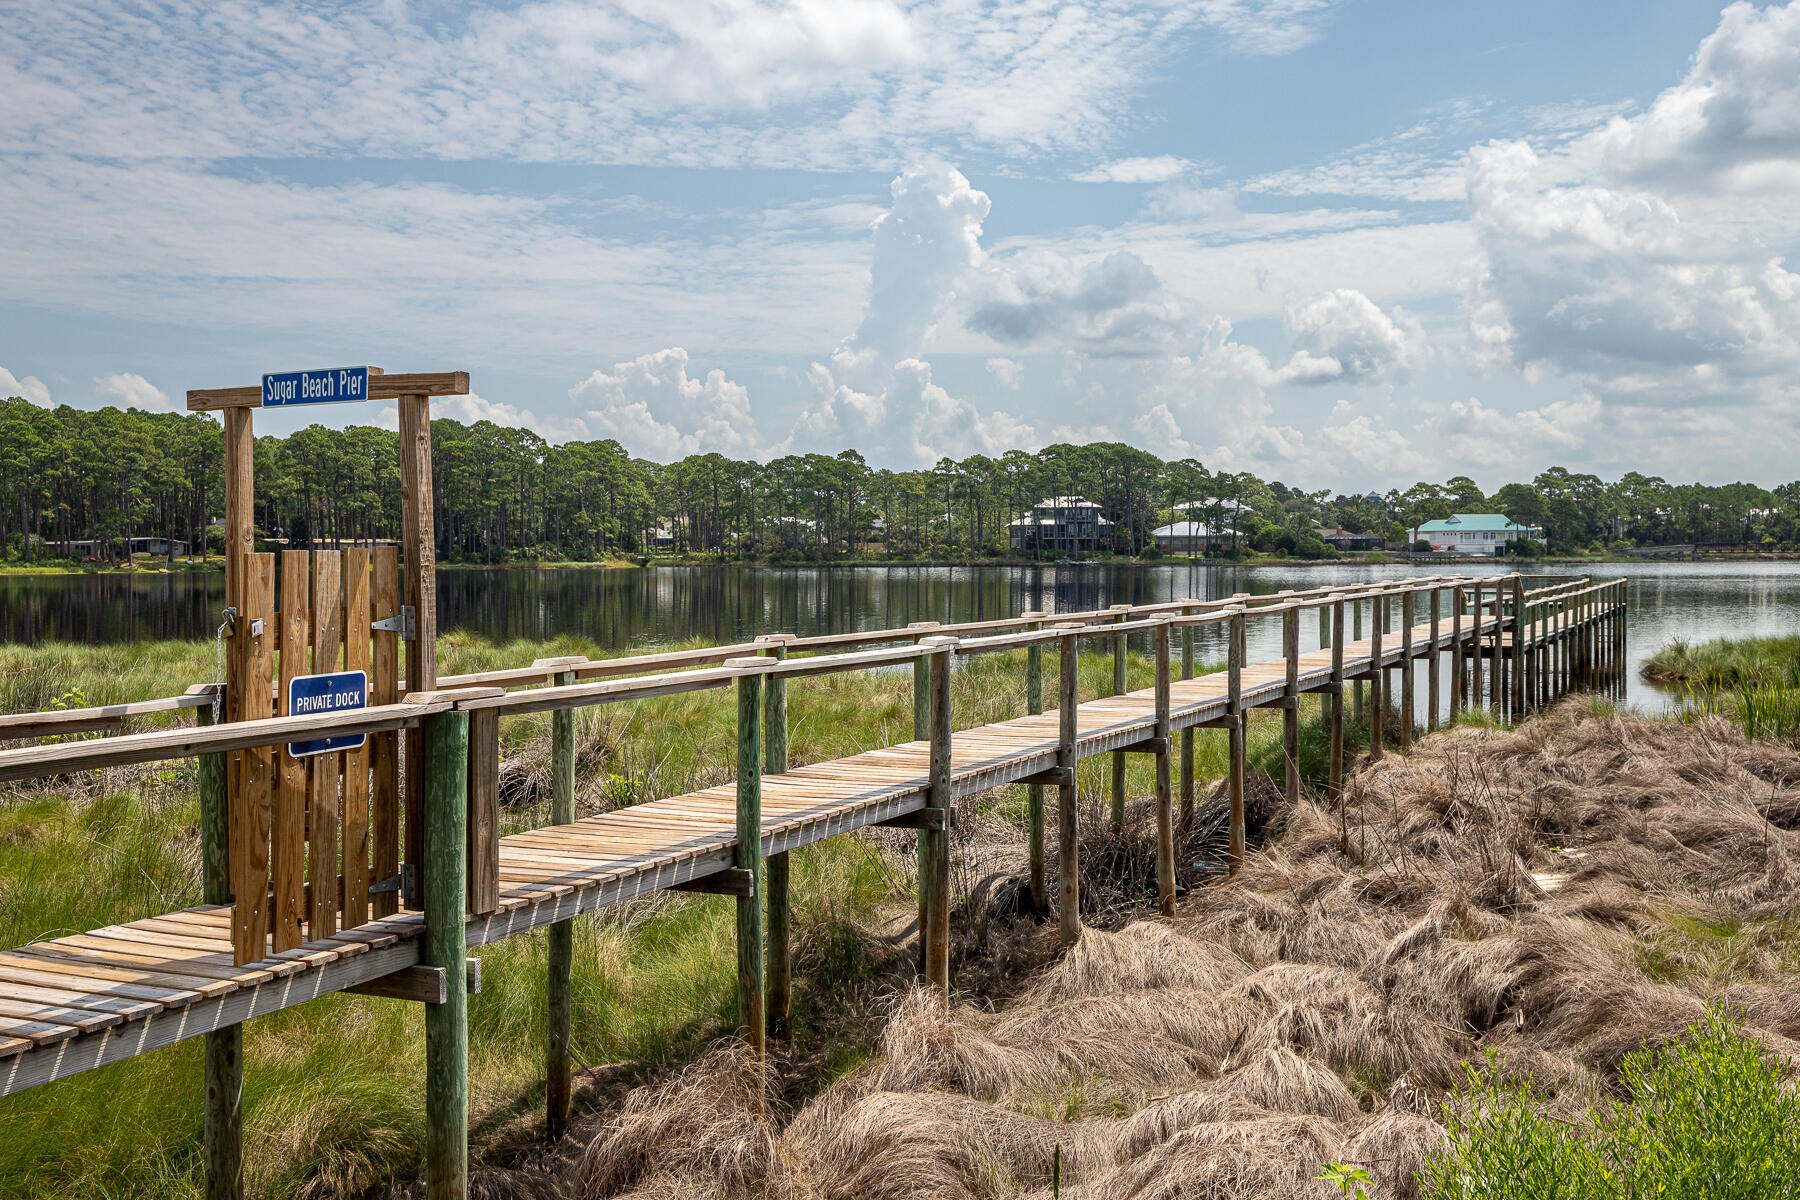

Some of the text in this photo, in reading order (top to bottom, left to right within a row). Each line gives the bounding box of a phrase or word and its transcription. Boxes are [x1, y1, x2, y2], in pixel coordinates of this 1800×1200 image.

[267, 369, 362, 404] Sugar Beach Pier
[297, 690, 360, 712] PRIVATE DOCK
